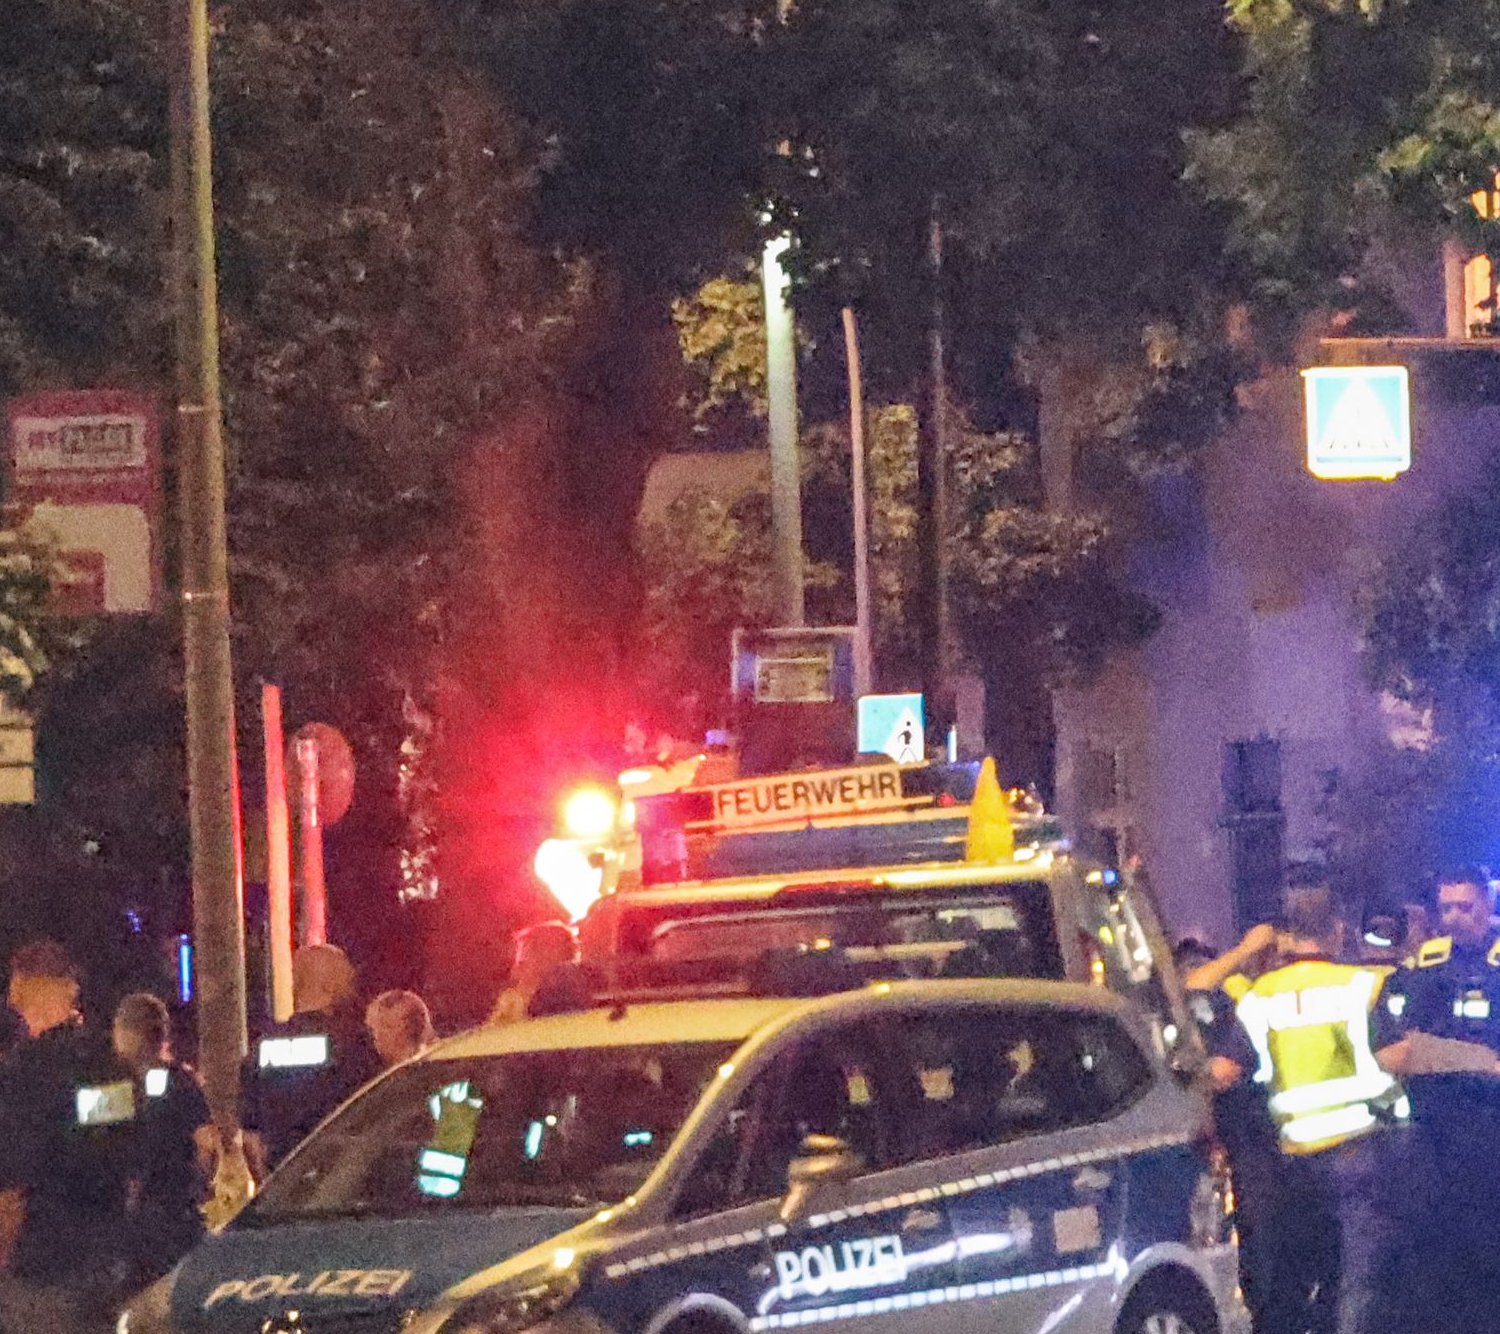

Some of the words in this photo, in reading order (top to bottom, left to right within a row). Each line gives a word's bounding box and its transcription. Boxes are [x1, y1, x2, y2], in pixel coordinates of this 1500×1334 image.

[715, 771, 898, 816] FEUERWEHR
[203, 1269, 412, 1309] POLIZEI
[776, 1234, 908, 1300] POLIZEI
